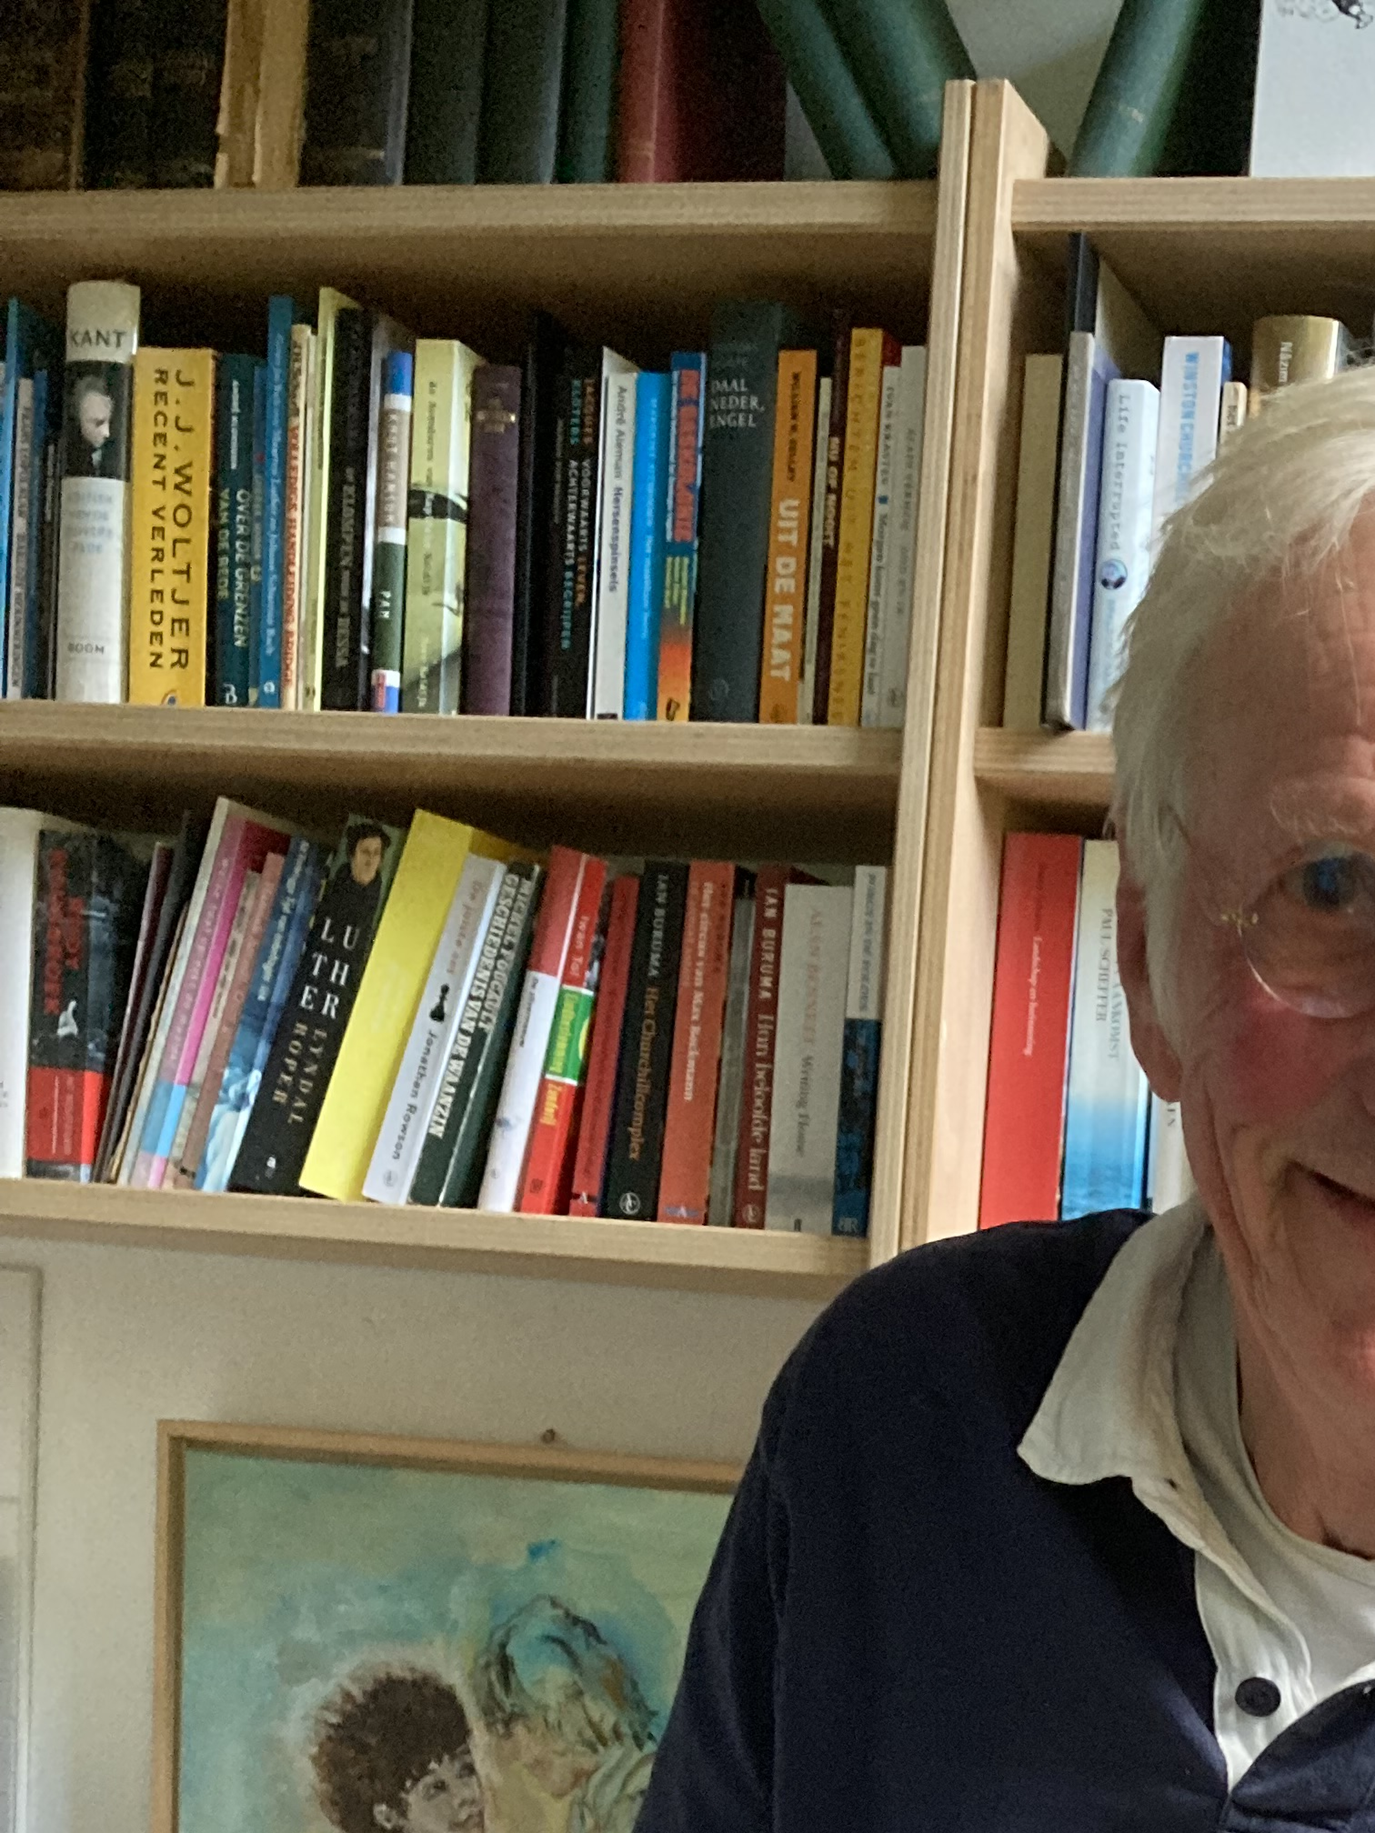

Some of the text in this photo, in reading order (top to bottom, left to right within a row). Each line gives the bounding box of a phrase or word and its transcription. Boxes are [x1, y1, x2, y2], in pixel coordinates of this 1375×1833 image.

[69, 328, 127, 349] KANT
[1179, 352, 1199, 420] WINSTON
[148, 368, 169, 671] RECENT VERLEDEN
[607, 385, 630, 593] André Aleman Hersenspinsels
[1108, 394, 1131, 550] Life Interrupted
[231, 488, 250, 648] OVER DE GRENZEN
[379, 590, 393, 619] PAN
[769, 498, 800, 681] UIT DE MAAT
[308, 952, 350, 987] TH
[319, 918, 359, 951] LU
[1095, 907, 1114, 1023] PAUL SCHEFFER
[298, 985, 342, 1021] ER
[286, 1028, 330, 1128] LYNDAL
